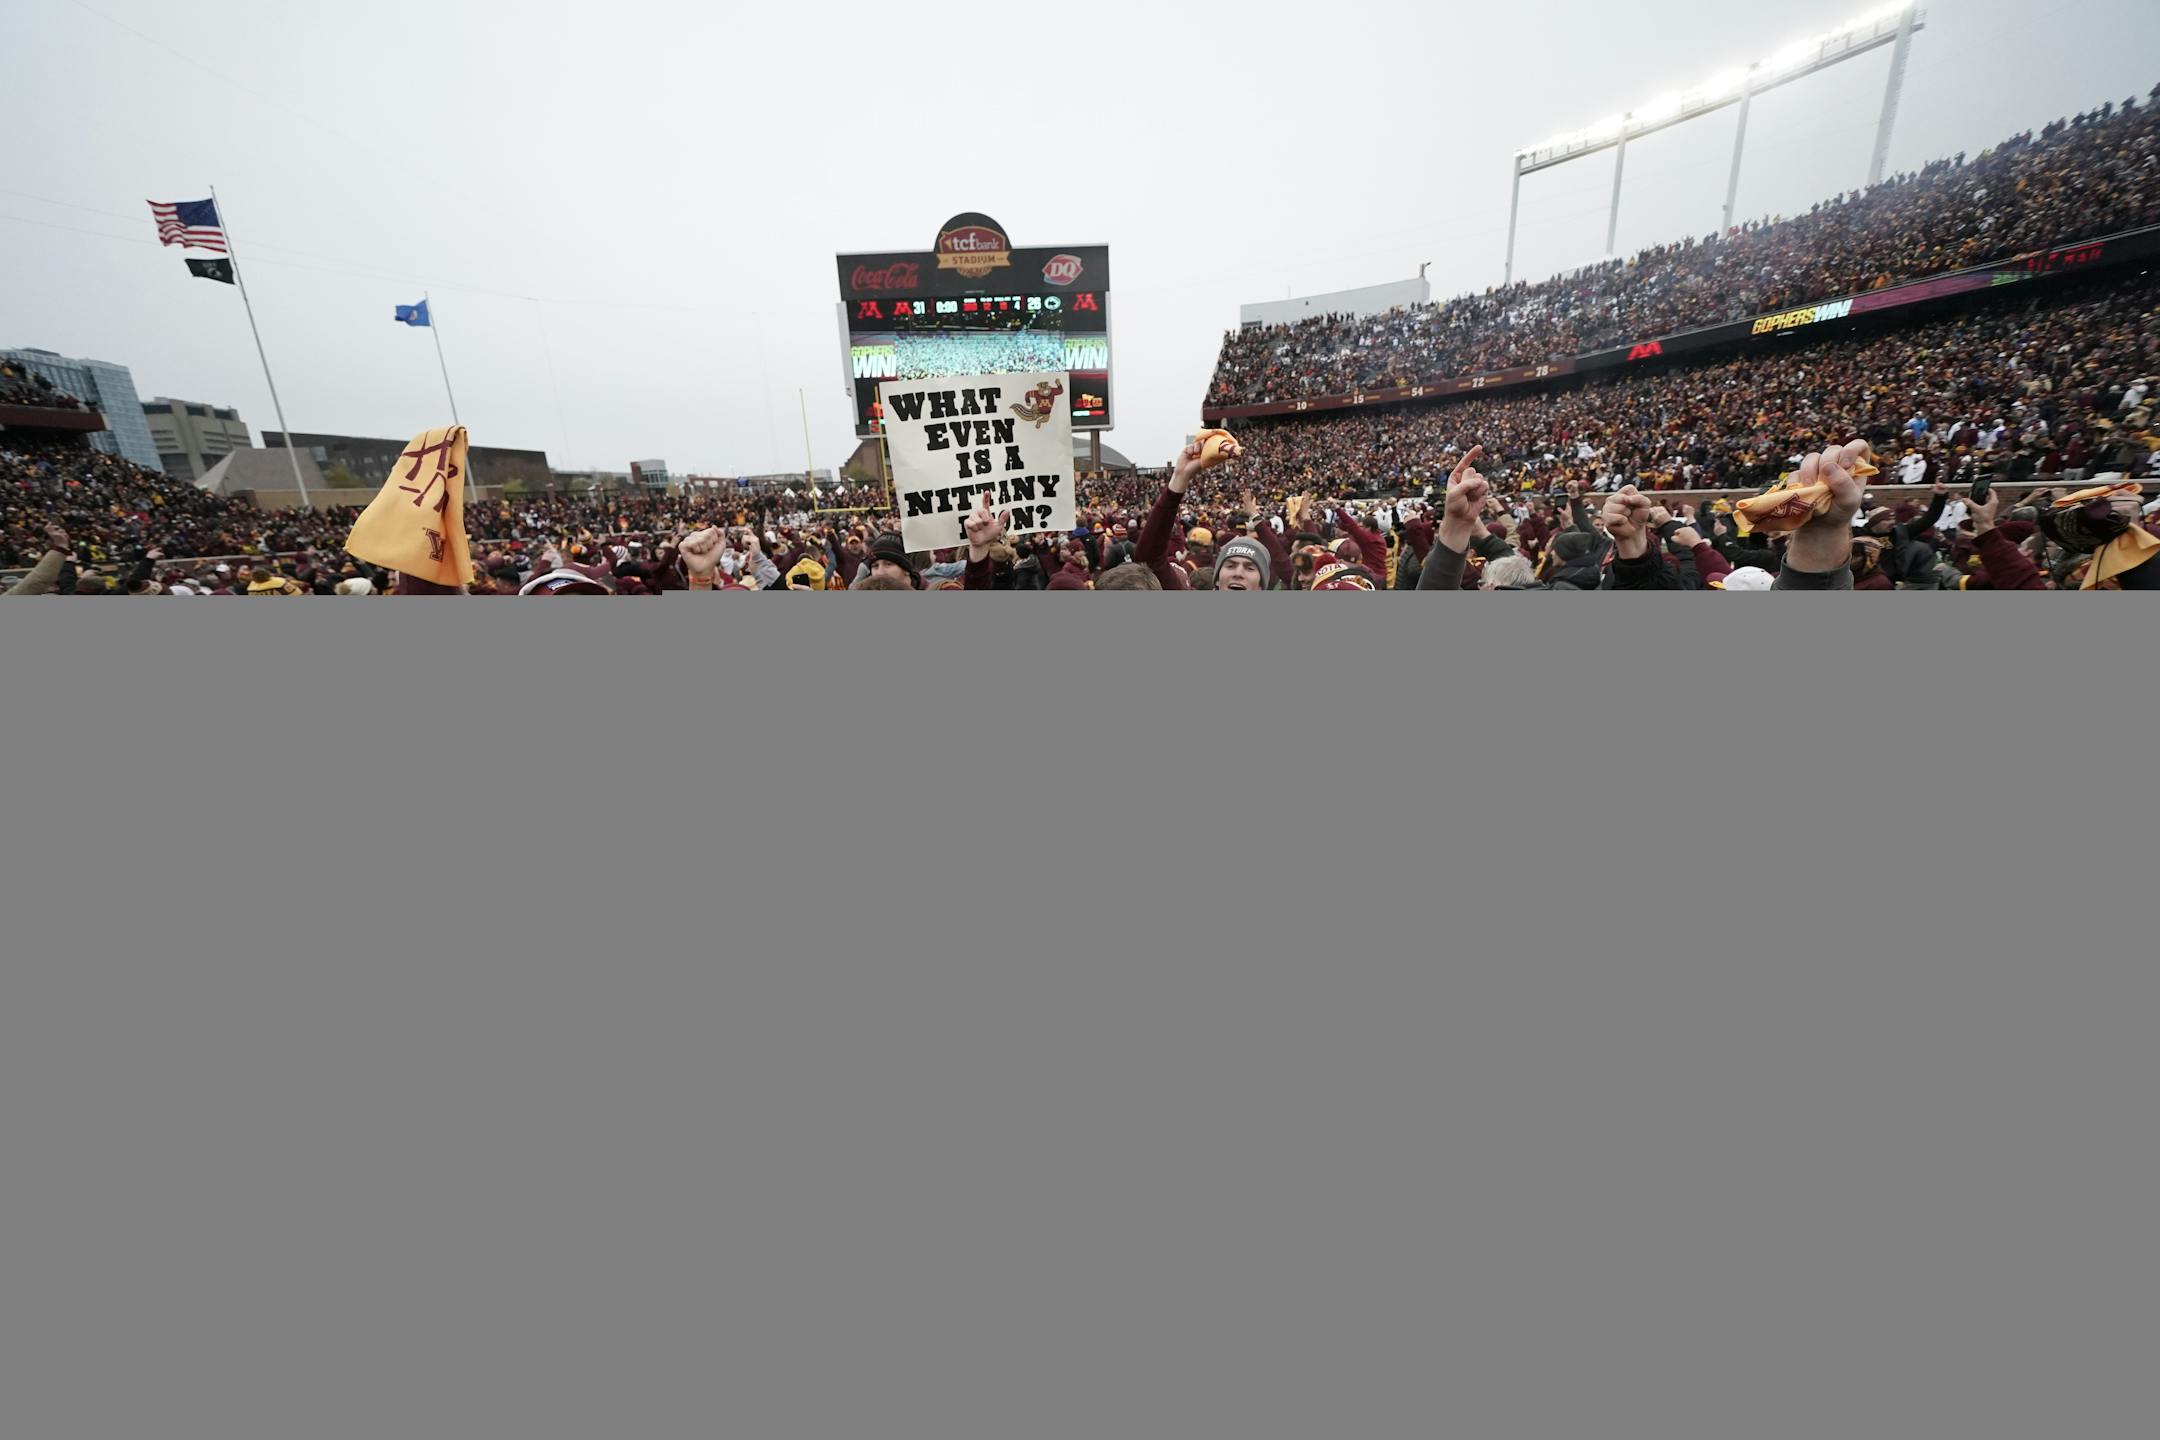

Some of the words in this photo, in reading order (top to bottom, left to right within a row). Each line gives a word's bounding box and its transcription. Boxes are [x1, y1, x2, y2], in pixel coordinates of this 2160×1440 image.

[952, 255, 996, 265] STADIUM
[1050, 262, 1077, 276] DQ
[912, 301, 925, 314] 31
[936, 300, 958, 314] 0:00
[851, 345, 895, 357] GOPHERS
[1536, 365, 1549, 377] 78
[1472, 377, 1485, 388] 72
[1411, 387, 1424, 397] 54
[889, 387, 1000, 421] WHAT
[1353, 395, 1364, 404] 15
[1296, 401, 1307, 411] 10
[924, 418, 1015, 450] EVEN
[956, 449, 992, 478] IS
[1005, 446, 1024, 470] A
[904, 475, 1060, 517] NITTANY
[1226, 546, 1255, 556] STORM
